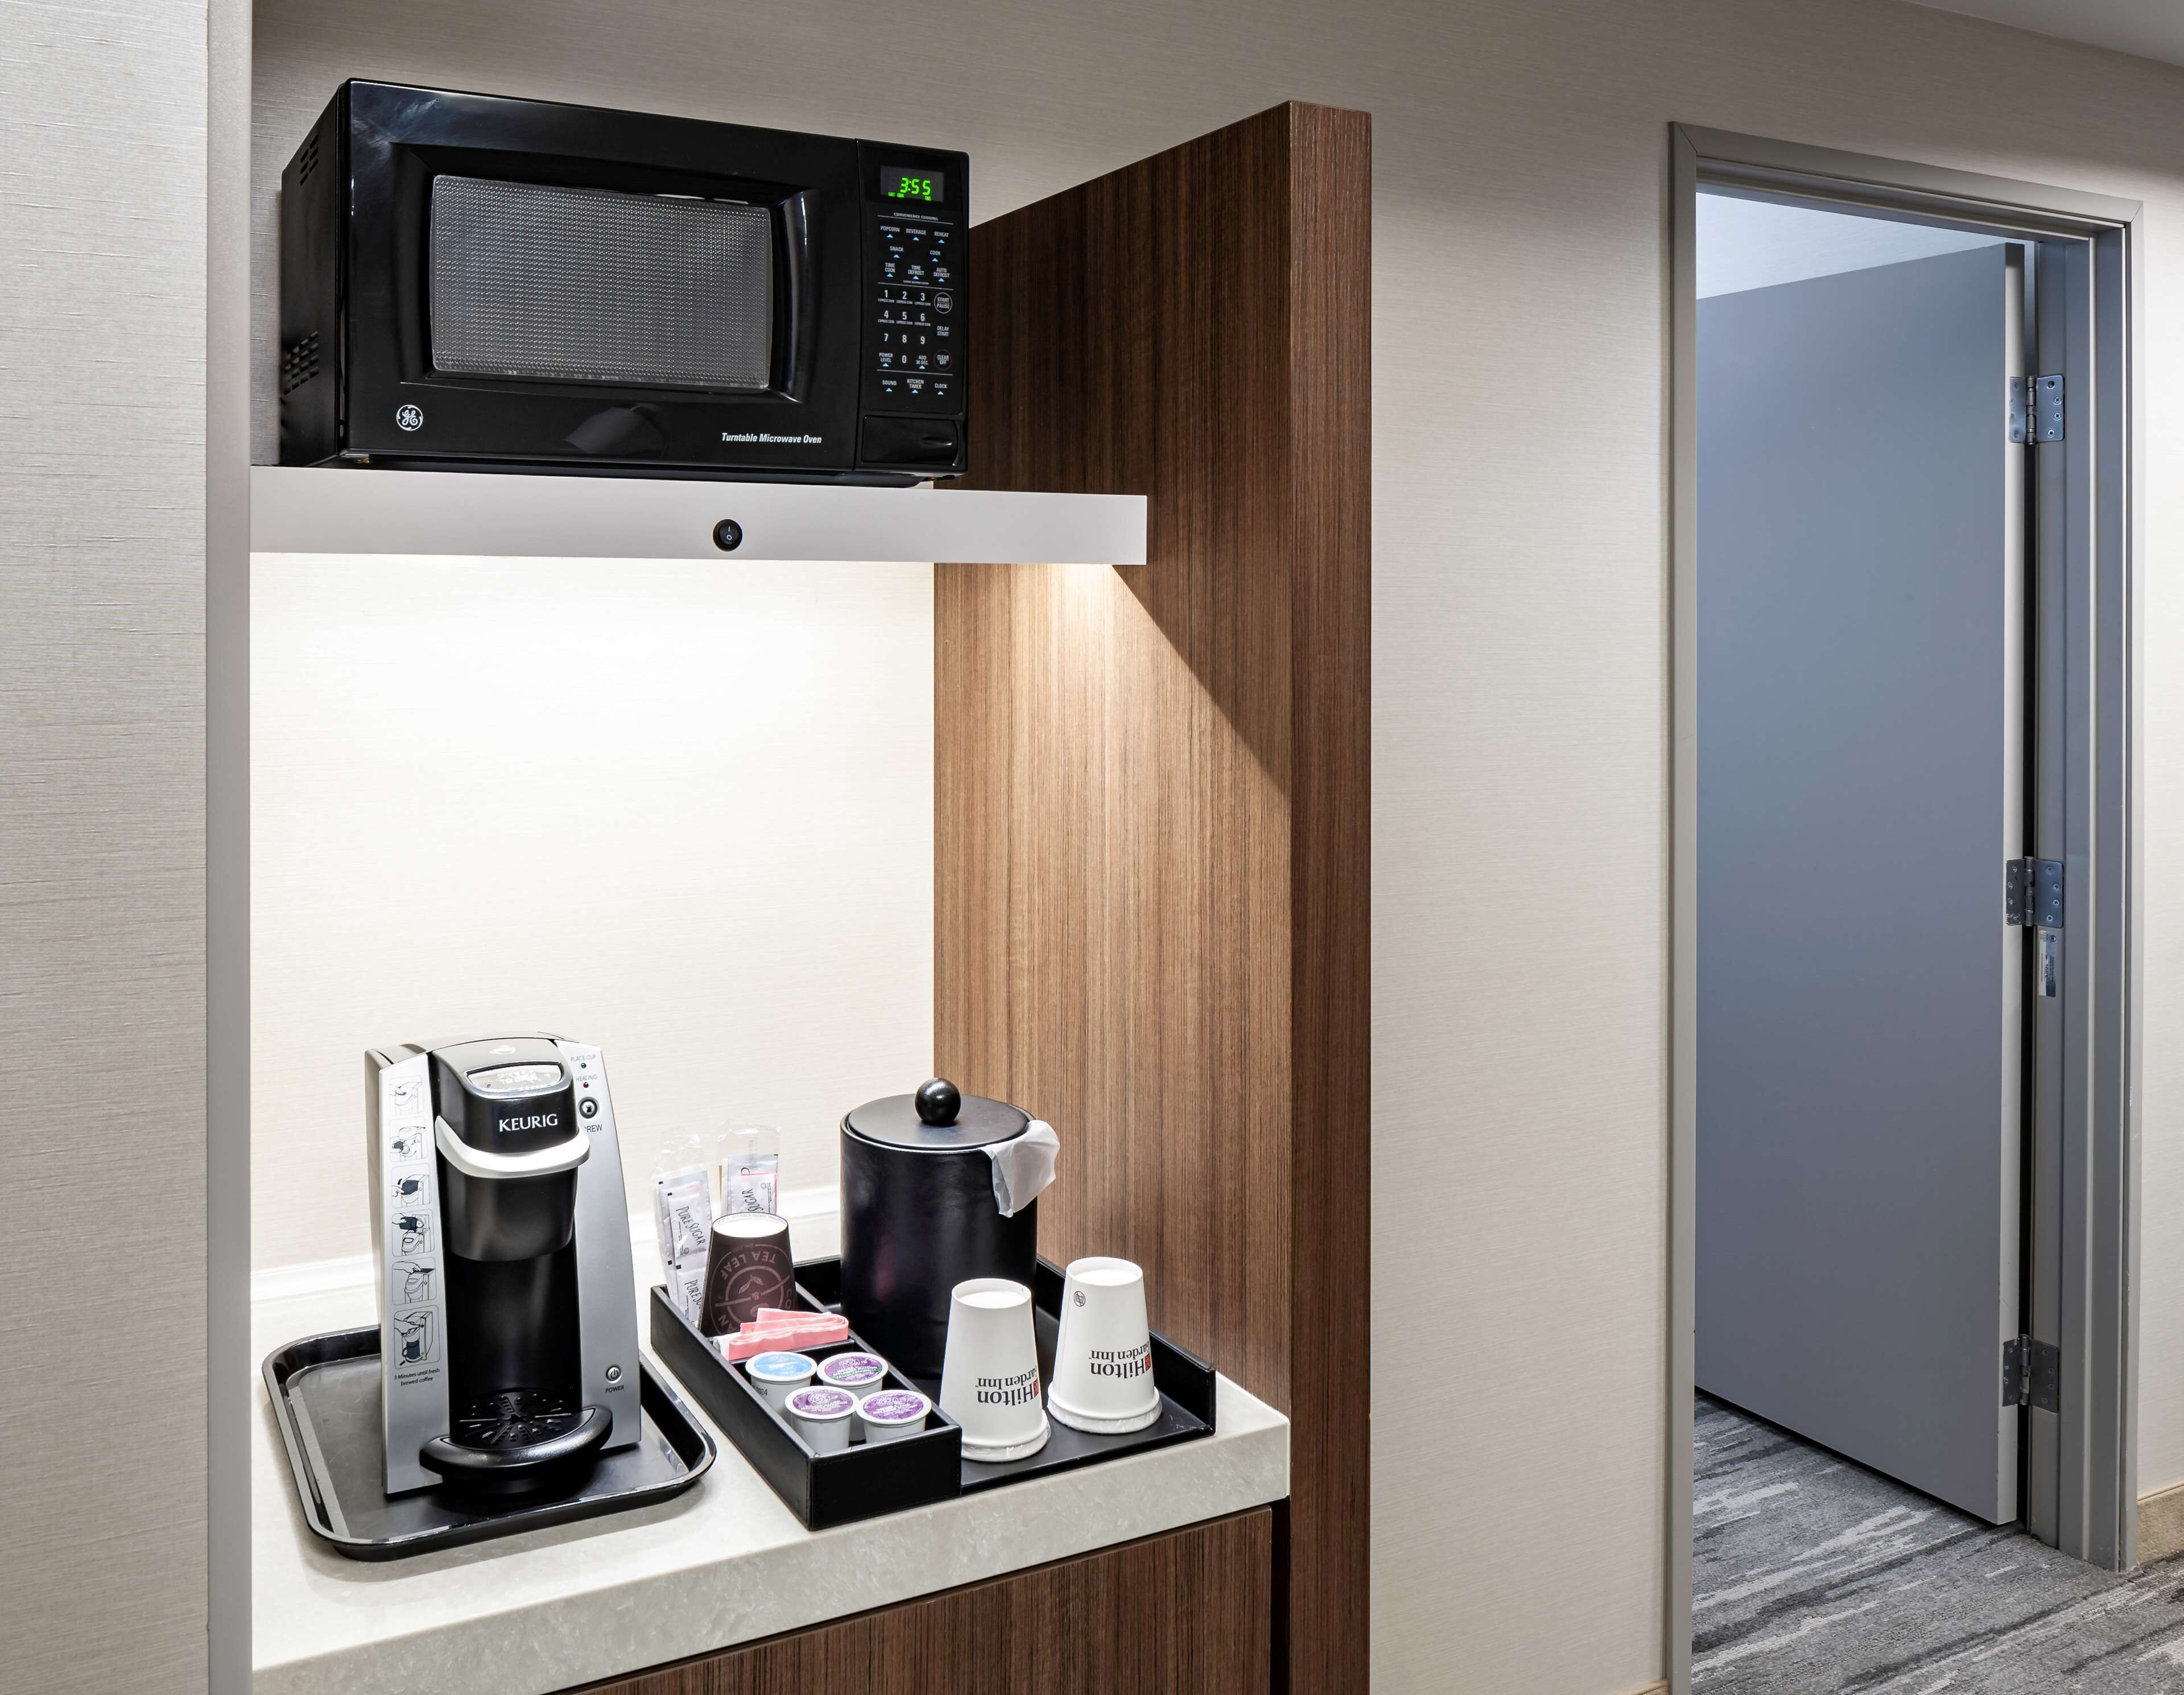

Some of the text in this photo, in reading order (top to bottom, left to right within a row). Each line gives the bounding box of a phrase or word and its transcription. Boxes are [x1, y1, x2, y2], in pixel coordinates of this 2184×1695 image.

[900, 177, 931, 195] 3:55
[884, 290, 888, 298] 1
[884, 310, 889, 319] 4
[883, 333, 888, 342] 7
[902, 334, 907, 343] 8
[902, 355, 907, 363] 0
[721, 432, 822, 444] Turntable Microwave Oven
[499, 1113, 558, 1132] KEURIG
[584, 1124, 602, 1133] REW
[742, 1189, 763, 1212] SUGAR
[676, 1206, 706, 1246] PURE SUGAR
[721, 1251, 777, 1280] TEA LEAF
[684, 1279, 702, 1298] PURE
[1091, 1350, 1115, 1362] Inn
[1090, 1358, 1145, 1379] Hilton
[605, 1384, 624, 1393] POWER
[977, 1378, 1002, 1390] Inn
[977, 1383, 1034, 1406] Hilton
